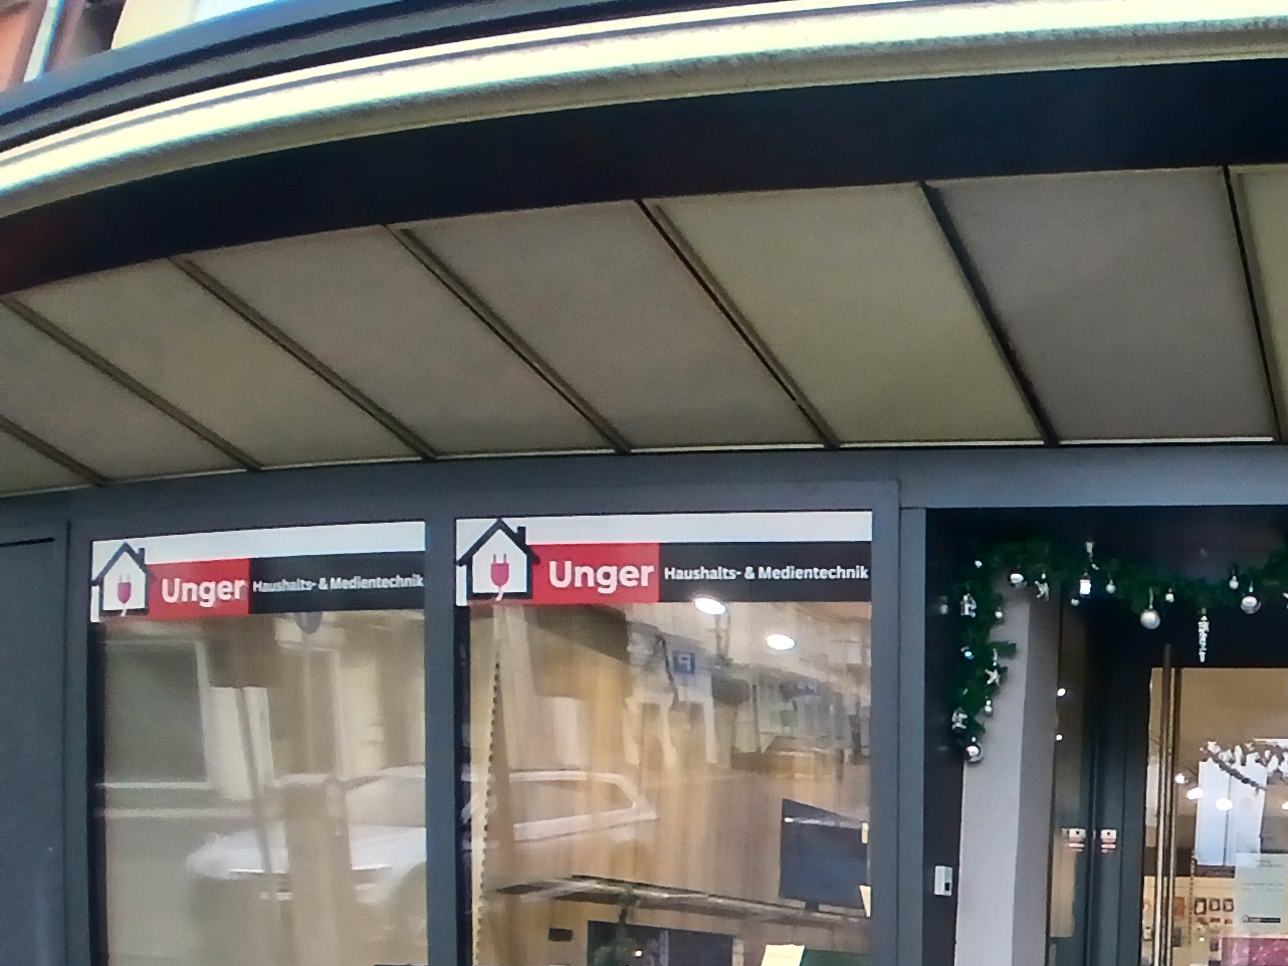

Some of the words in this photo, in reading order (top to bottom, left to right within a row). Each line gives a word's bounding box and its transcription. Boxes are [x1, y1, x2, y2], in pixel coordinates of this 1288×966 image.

[162, 577, 246, 608] Unger
[252, 577, 317, 593] Haushalts-
[318, 577, 329, 591] &
[330, 573, 425, 590] Medientechnik
[548, 560, 656, 595] Unger
[664, 565, 742, 580] Haushalts-
[744, 566, 756, 580] &
[758, 565, 870, 580] Medientechnik
